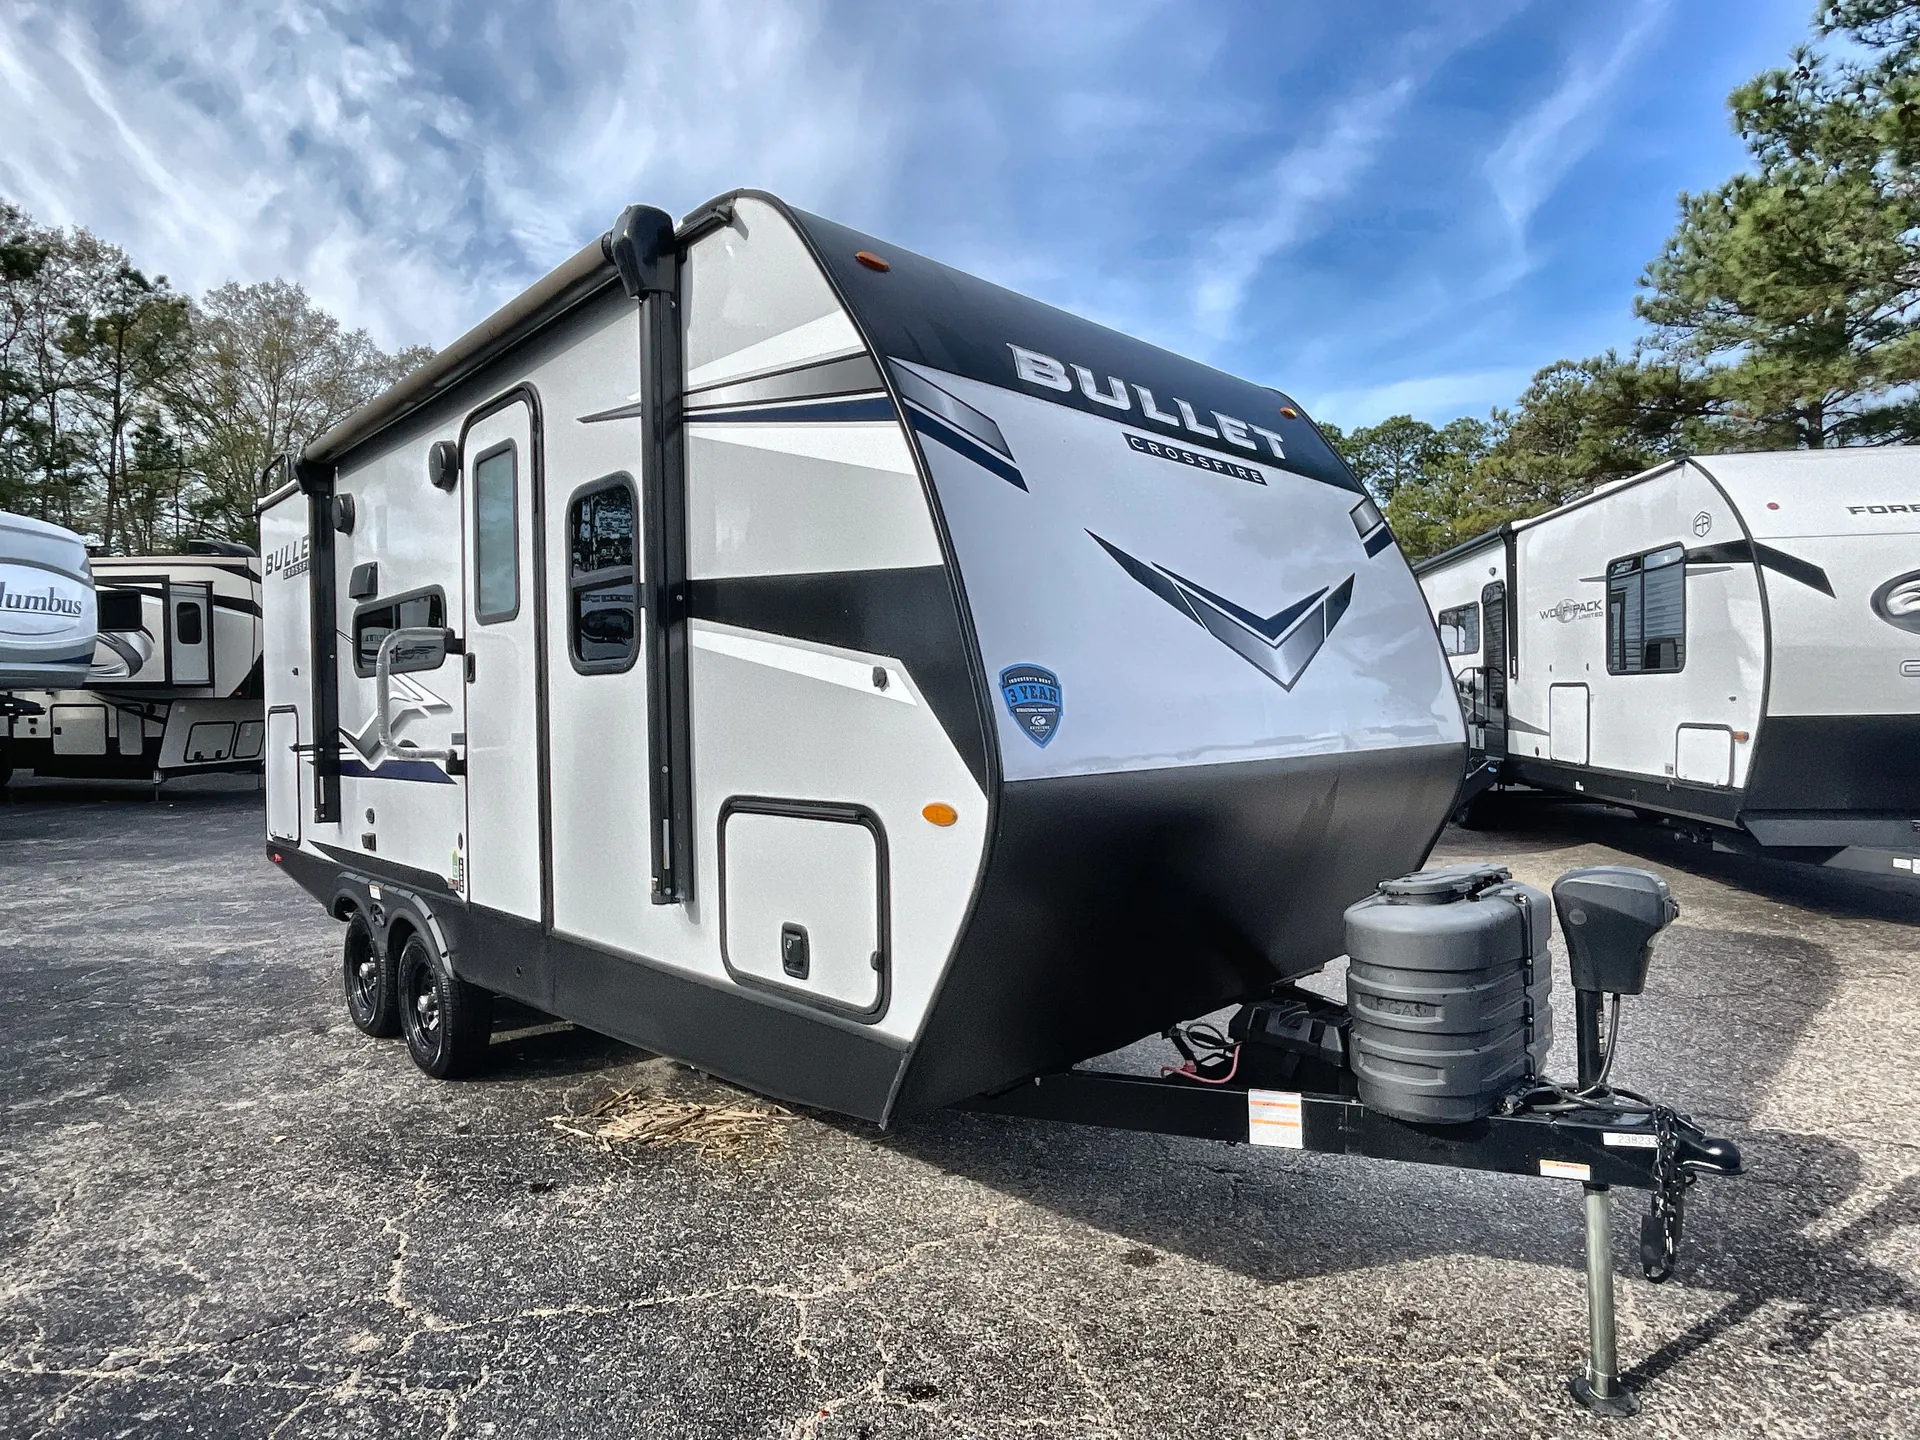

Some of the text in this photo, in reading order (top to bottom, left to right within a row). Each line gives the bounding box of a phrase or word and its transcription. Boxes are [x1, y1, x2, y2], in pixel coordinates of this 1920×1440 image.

[1005, 342, 1287, 460] BULLET
[1129, 437, 1263, 483] CROSSFIRE
[265, 534, 310, 576] BULLE
[1008, 685, 1058, 703] 3 YEAR
